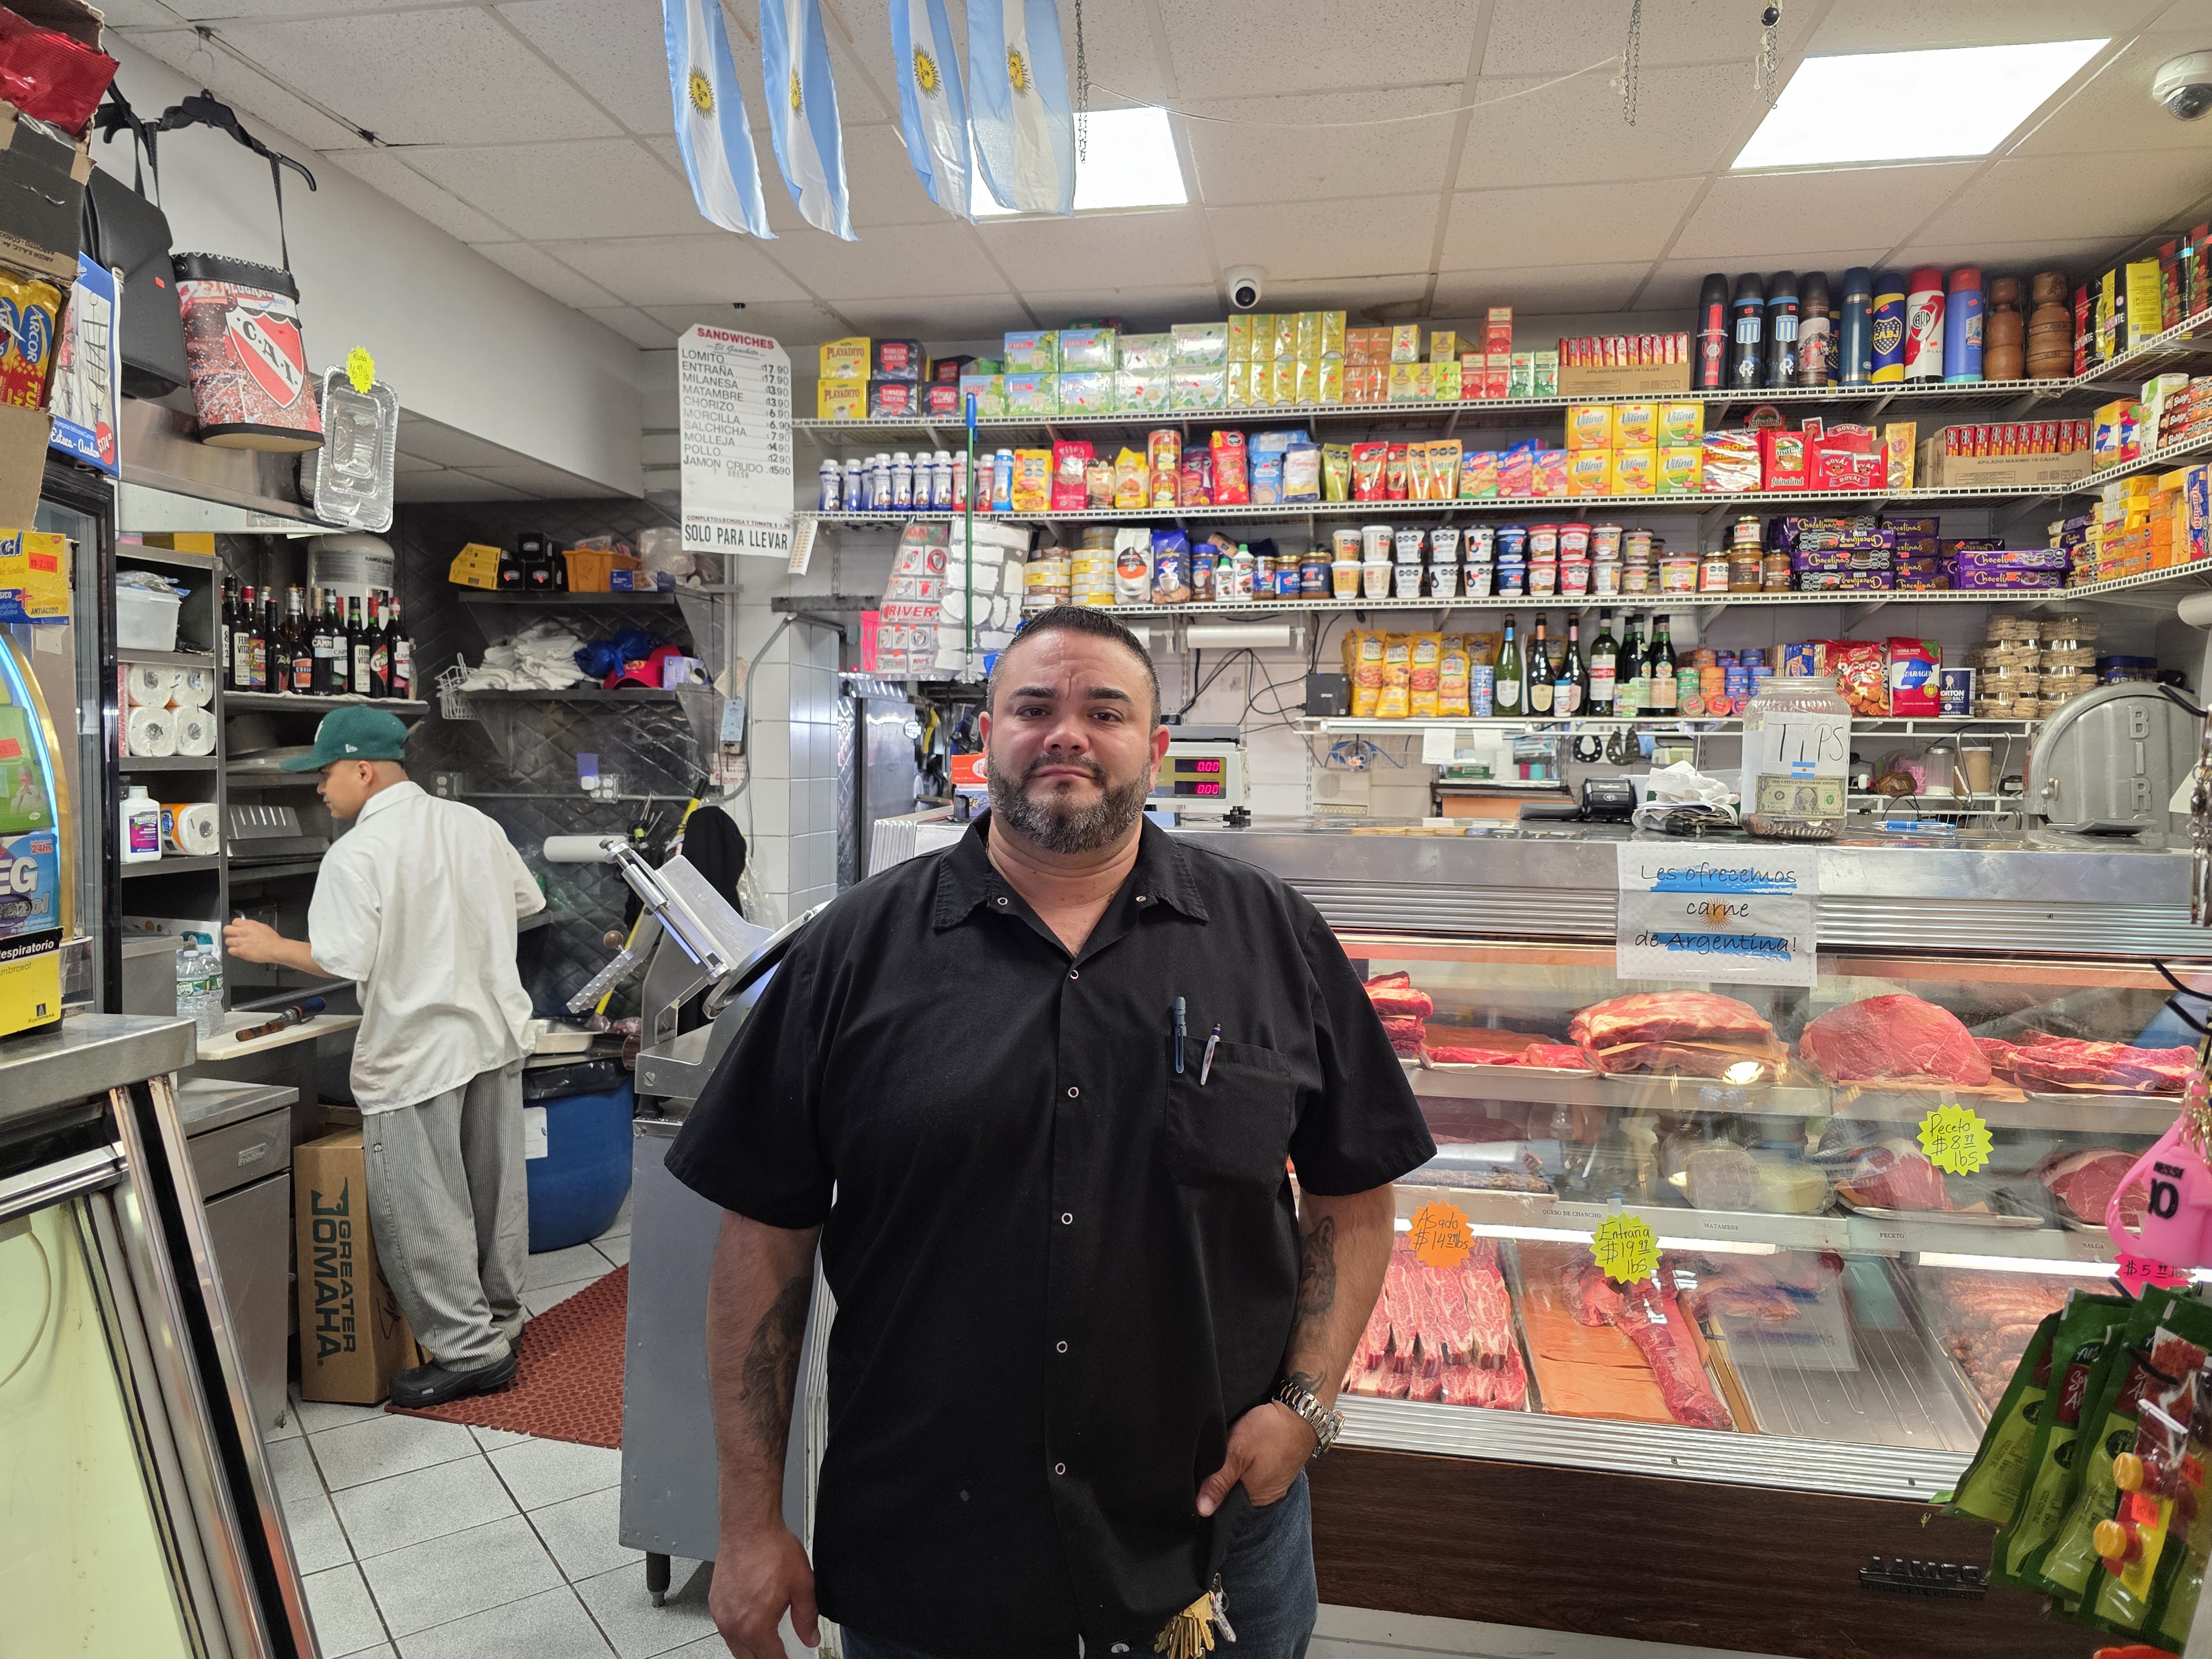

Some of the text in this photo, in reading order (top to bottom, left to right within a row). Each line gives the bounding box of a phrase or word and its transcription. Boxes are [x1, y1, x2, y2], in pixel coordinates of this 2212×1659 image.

[27, 305, 44, 363] ARCOR
[697, 327, 775, 349] SANDWICHES
[1874, 330, 1900, 341] CABJ
[682, 348, 725, 364] LOMITO
[826, 347, 864, 359] PLAYADITO
[682, 361, 734, 378] ENTRAÑA
[683, 373, 739, 390] MILANESA
[683, 384, 744, 402] MATAMBRE
[824, 389, 860, 402] PLAYADITO
[684, 395, 734, 412] CHORIZO
[684, 409, 741, 425] MORCILLA
[1577, 414, 1604, 426] Vitina
[1622, 413, 1650, 424] Vitina
[1667, 411, 1694, 422] Vitina
[684, 420, 747, 436] SALCHICHA
[685, 432, 735, 447] MOLLEJA
[685, 444, 721, 457] POLLO
[684, 455, 721, 468] JAMON
[726, 460, 764, 474] CRUDO
[1576, 461, 1603, 472] Vitina
[1620, 460, 1647, 471] Vitina
[1666, 458, 1693, 469] Vitina
[1825, 458, 1848, 467] ROYAL
[1797, 518, 1837, 531] Chocolinas
[685, 524, 787, 550] SOLO PARA LLEVAR
[1808, 553, 1850, 566] Chocolinas
[31, 607, 59, 615] ANTIÁCIDO
[888, 605, 935, 617] RIVER
[1197, 762, 1219, 772] 0.00
[1197, 785, 1219, 794] 0.00
[31, 844, 53, 854] 24hs
[1641, 862, 1797, 888] Les ofrecemos
[1686, 901, 1749, 917] carne
[0, 940, 54, 959] espiratorio
[1635, 930, 1797, 955] de Argentina!
[1929, 1113, 1970, 1137] Peceto
[2148, 1178, 2179, 1219] 10
[1416, 1206, 1459, 1230] Asado
[1542, 1208, 1562, 1217] QUESO
[1598, 1222, 1651, 1241] Entraña
[1704, 1222, 1740, 1231] MATAMBRE
[2082, 1241, 2105, 1251] NALGA
[312, 1218, 341, 1360] OMAHA
[338, 1219, 356, 1353] GREATER
